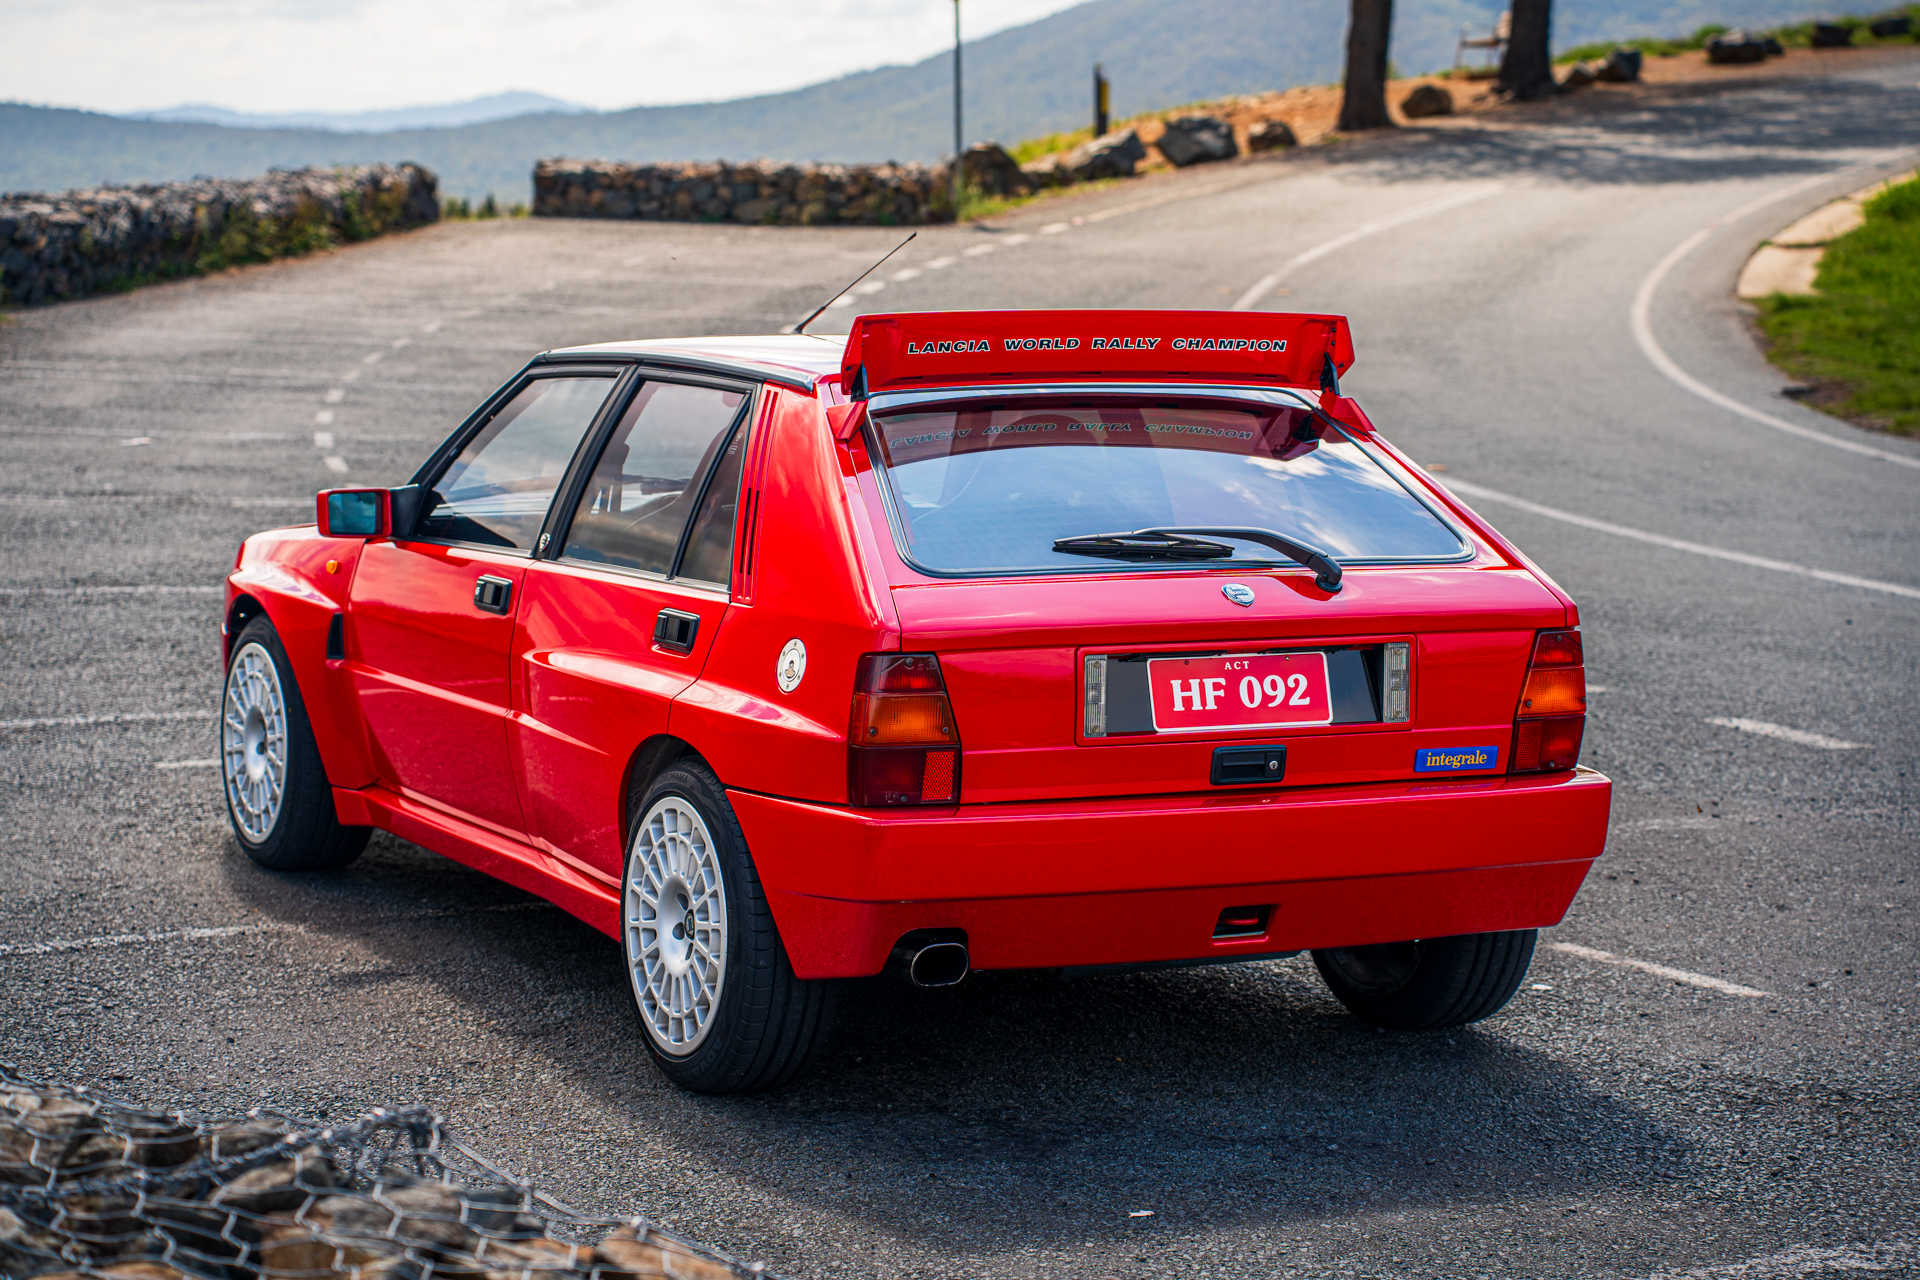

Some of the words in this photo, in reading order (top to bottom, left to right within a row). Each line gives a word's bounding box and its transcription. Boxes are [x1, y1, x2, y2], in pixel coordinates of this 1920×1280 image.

[907, 339, 990, 354] LANCIA
[1004, 337, 1080, 351] WORLD
[1091, 337, 1161, 350] RALLY
[1172, 338, 1287, 352] CHAMPION
[1224, 661, 1250, 670] ACT
[1170, 677, 1226, 711] HF
[1239, 673, 1310, 708] 092
[1426, 750, 1487, 768] integrale
